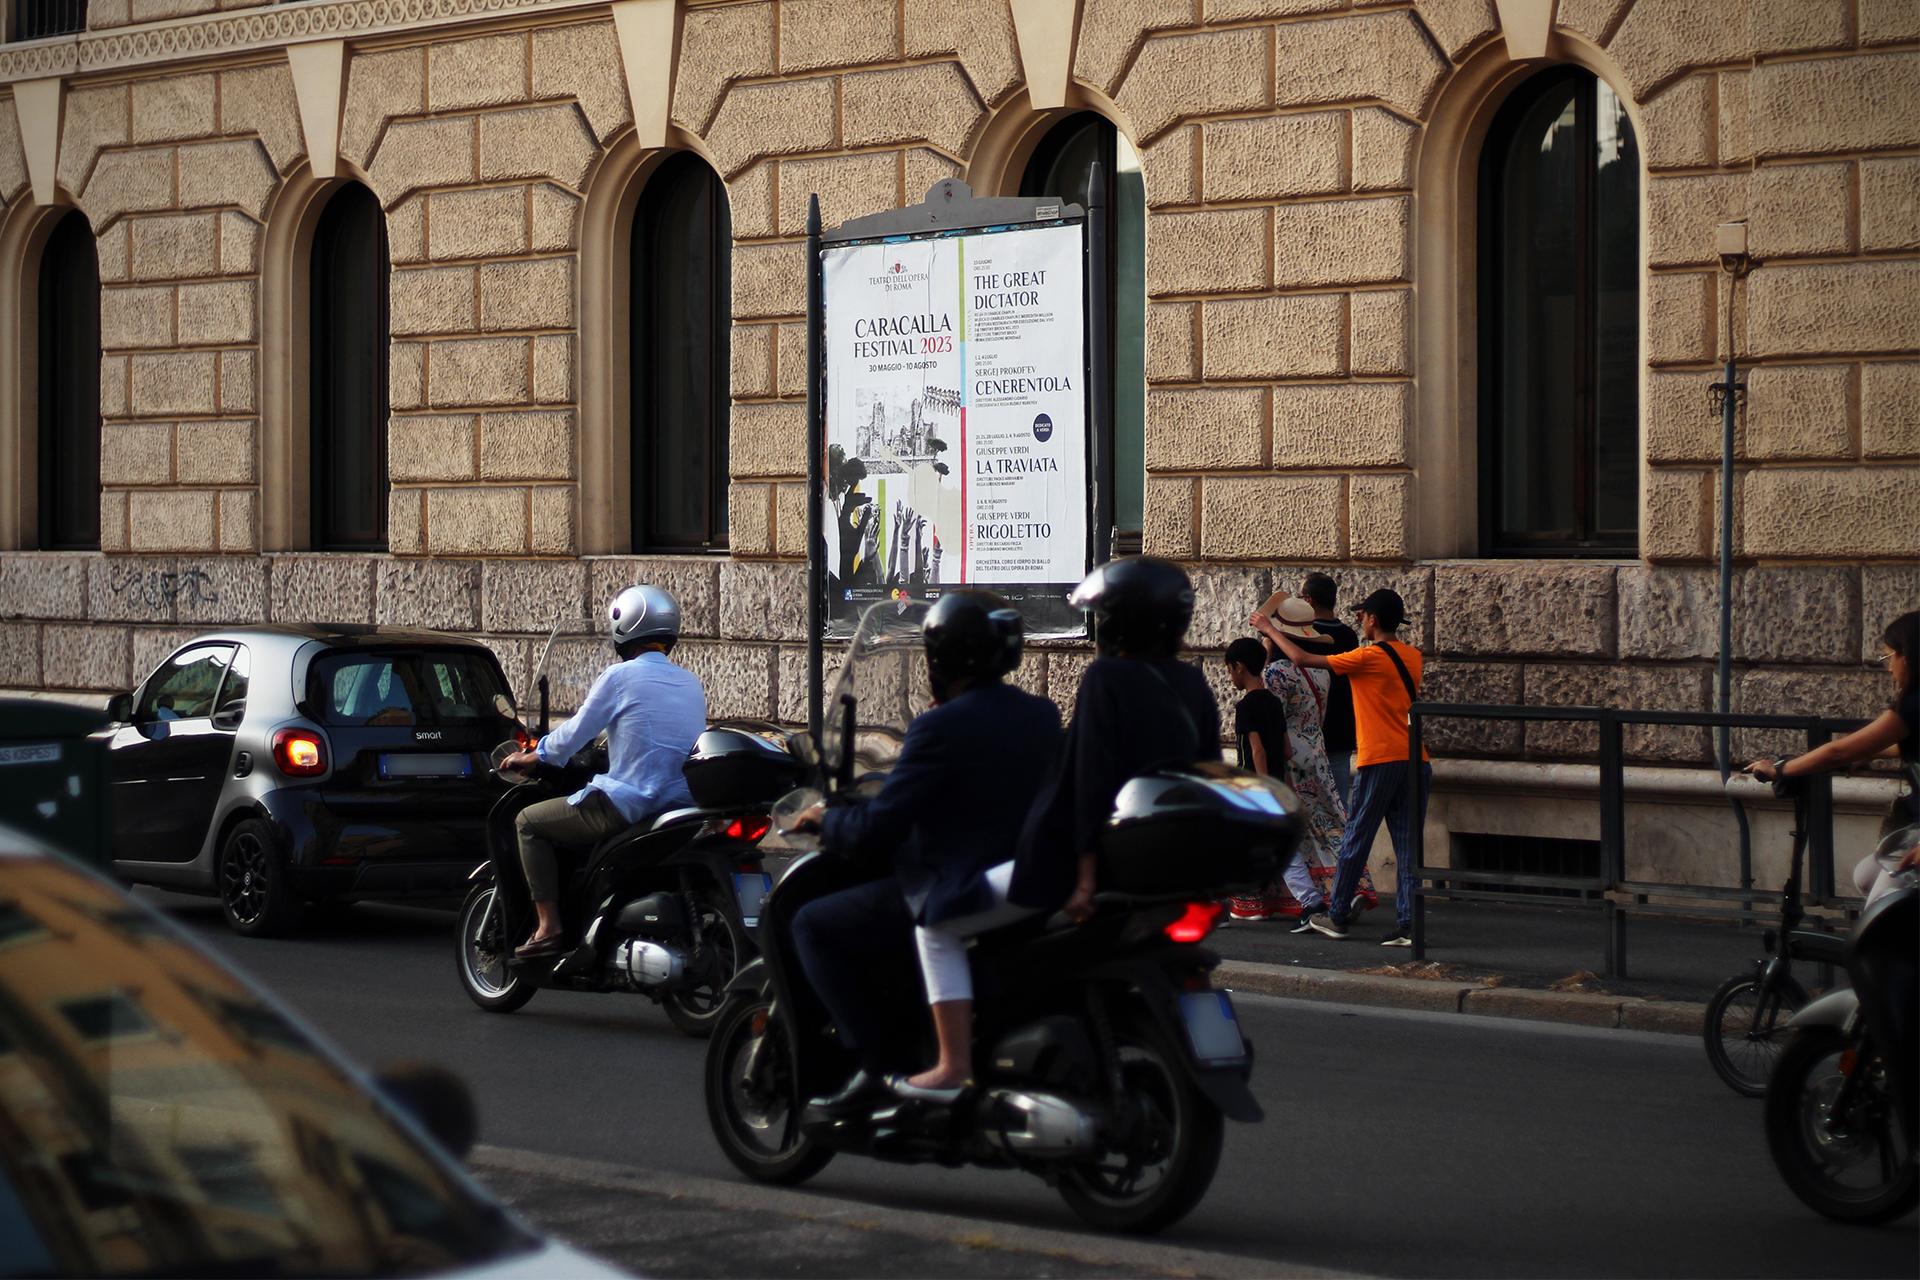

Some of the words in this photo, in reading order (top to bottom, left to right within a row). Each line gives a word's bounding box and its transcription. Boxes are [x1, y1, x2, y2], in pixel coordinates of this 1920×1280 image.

[869, 276, 893, 286] TEATRO
[885, 284, 893, 292] DI
[894, 282, 913, 291] ROMA
[974, 274, 1000, 290] THE
[1003, 270, 1046, 288] GREAT
[975, 291, 1039, 310] DICTATOR
[855, 313, 952, 339] CARACALLA
[854, 339, 917, 358] FESTIVAL
[920, 336, 952, 354] 2023
[869, 364, 877, 373] 30
[877, 363, 902, 372] MAGGIO
[906, 362, 913, 370] 10
[913, 360, 938, 370] AGOSTO
[975, 368, 999, 377] SERGEJ
[1000, 365, 1036, 375] PROKOF'EV
[975, 376, 1072, 396] CENERENTOLA
[976, 446, 1008, 456] GIUSEPPE
[1009, 446, 1030, 455] VERDI
[976, 460, 993, 475] LA
[996, 457, 1058, 474] TRAVIATA
[976, 512, 1010, 521] GIUSEPPE
[1010, 511, 1030, 520] VERDI
[976, 523, 1051, 540] RIGOLETTO
[415, 731, 442, 740] smart
